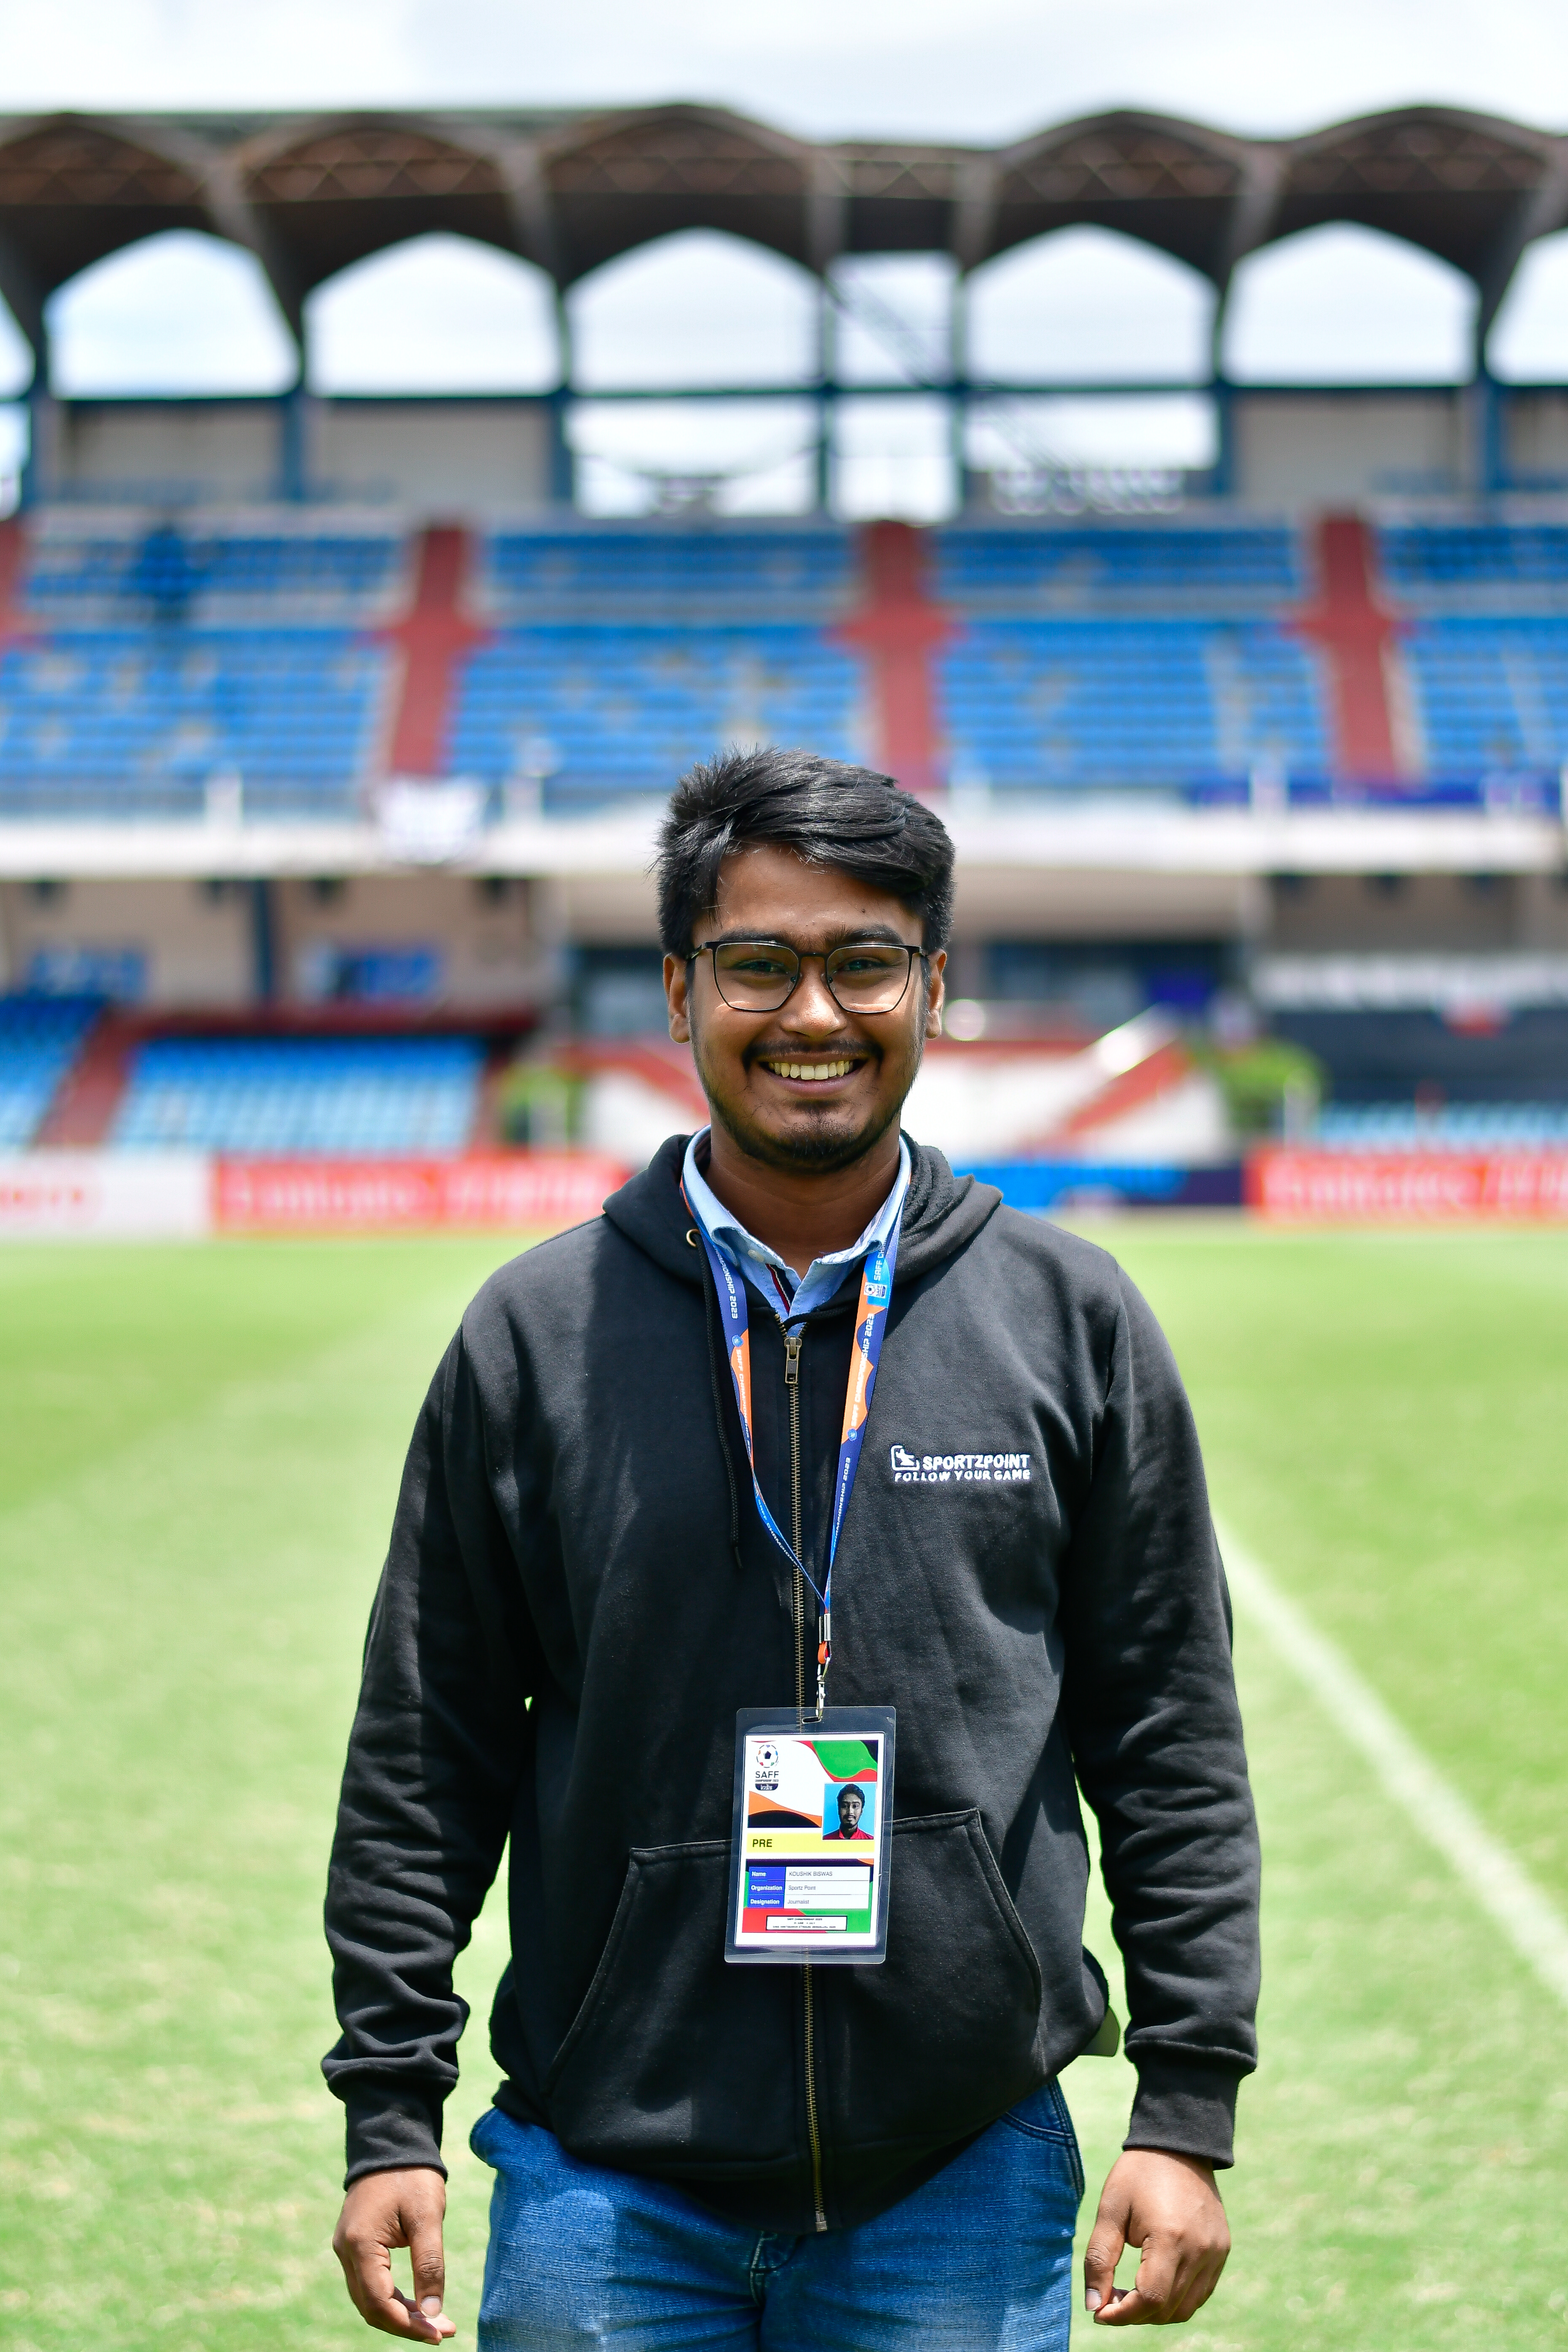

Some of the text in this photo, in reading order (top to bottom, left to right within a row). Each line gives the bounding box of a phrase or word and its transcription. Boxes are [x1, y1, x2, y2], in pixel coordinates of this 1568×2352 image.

[874, 1260, 883, 1281] SAFF
[730, 1296, 738, 1319] 2023
[851, 1313, 875, 1427] SAFF CHAMPIONSHIP 2023
[739, 1373, 749, 1438] CHAMPIONSHIP
[922, 1454, 1031, 1471] SPORTZPOINT
[894, 1469, 1031, 1482] FOLLOW YOUR GAME
[752, 1839, 773, 1848] PRE
